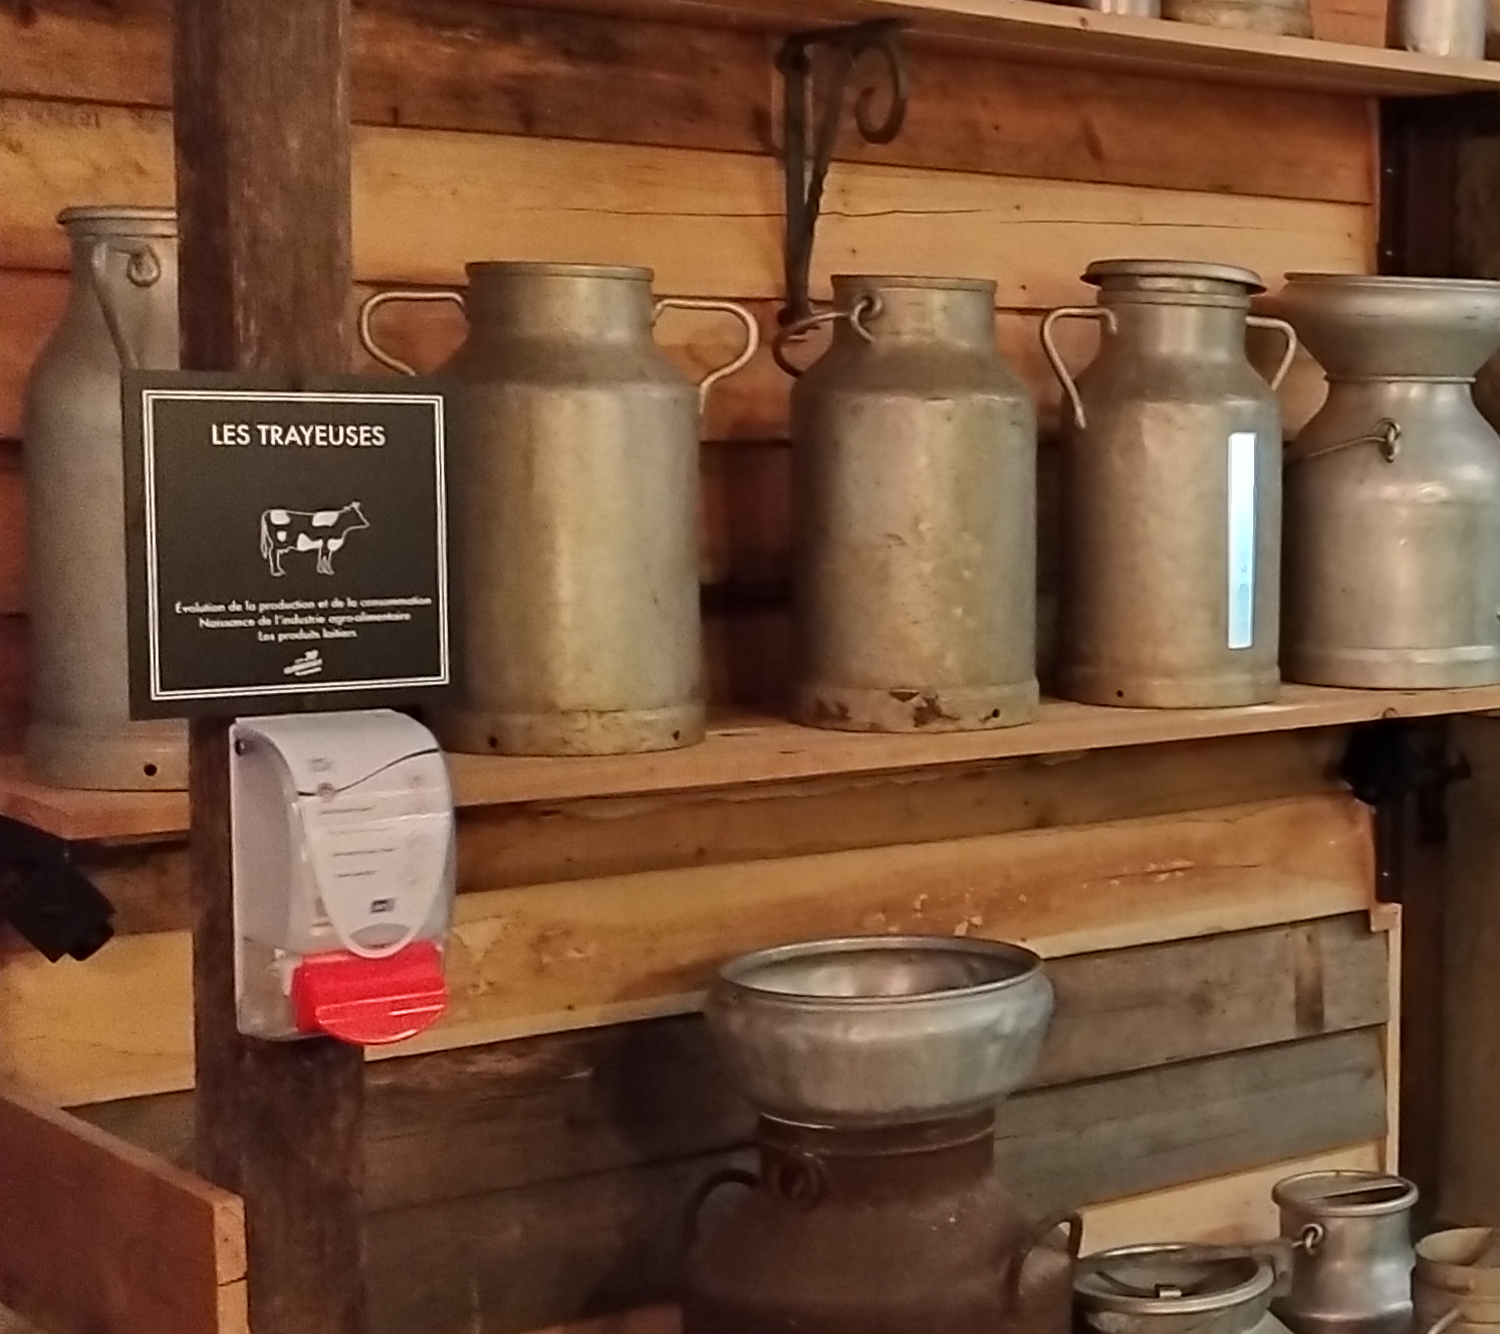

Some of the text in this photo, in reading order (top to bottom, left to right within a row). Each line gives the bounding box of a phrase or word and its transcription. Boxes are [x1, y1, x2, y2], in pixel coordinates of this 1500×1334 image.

[211, 424, 387, 447] LES TRAYEUSES
[227, 599, 243, 612] de
[244, 600, 256, 612] la
[258, 598, 315, 613] production
[330, 596, 345, 609] de
[257, 615, 272, 627] de
